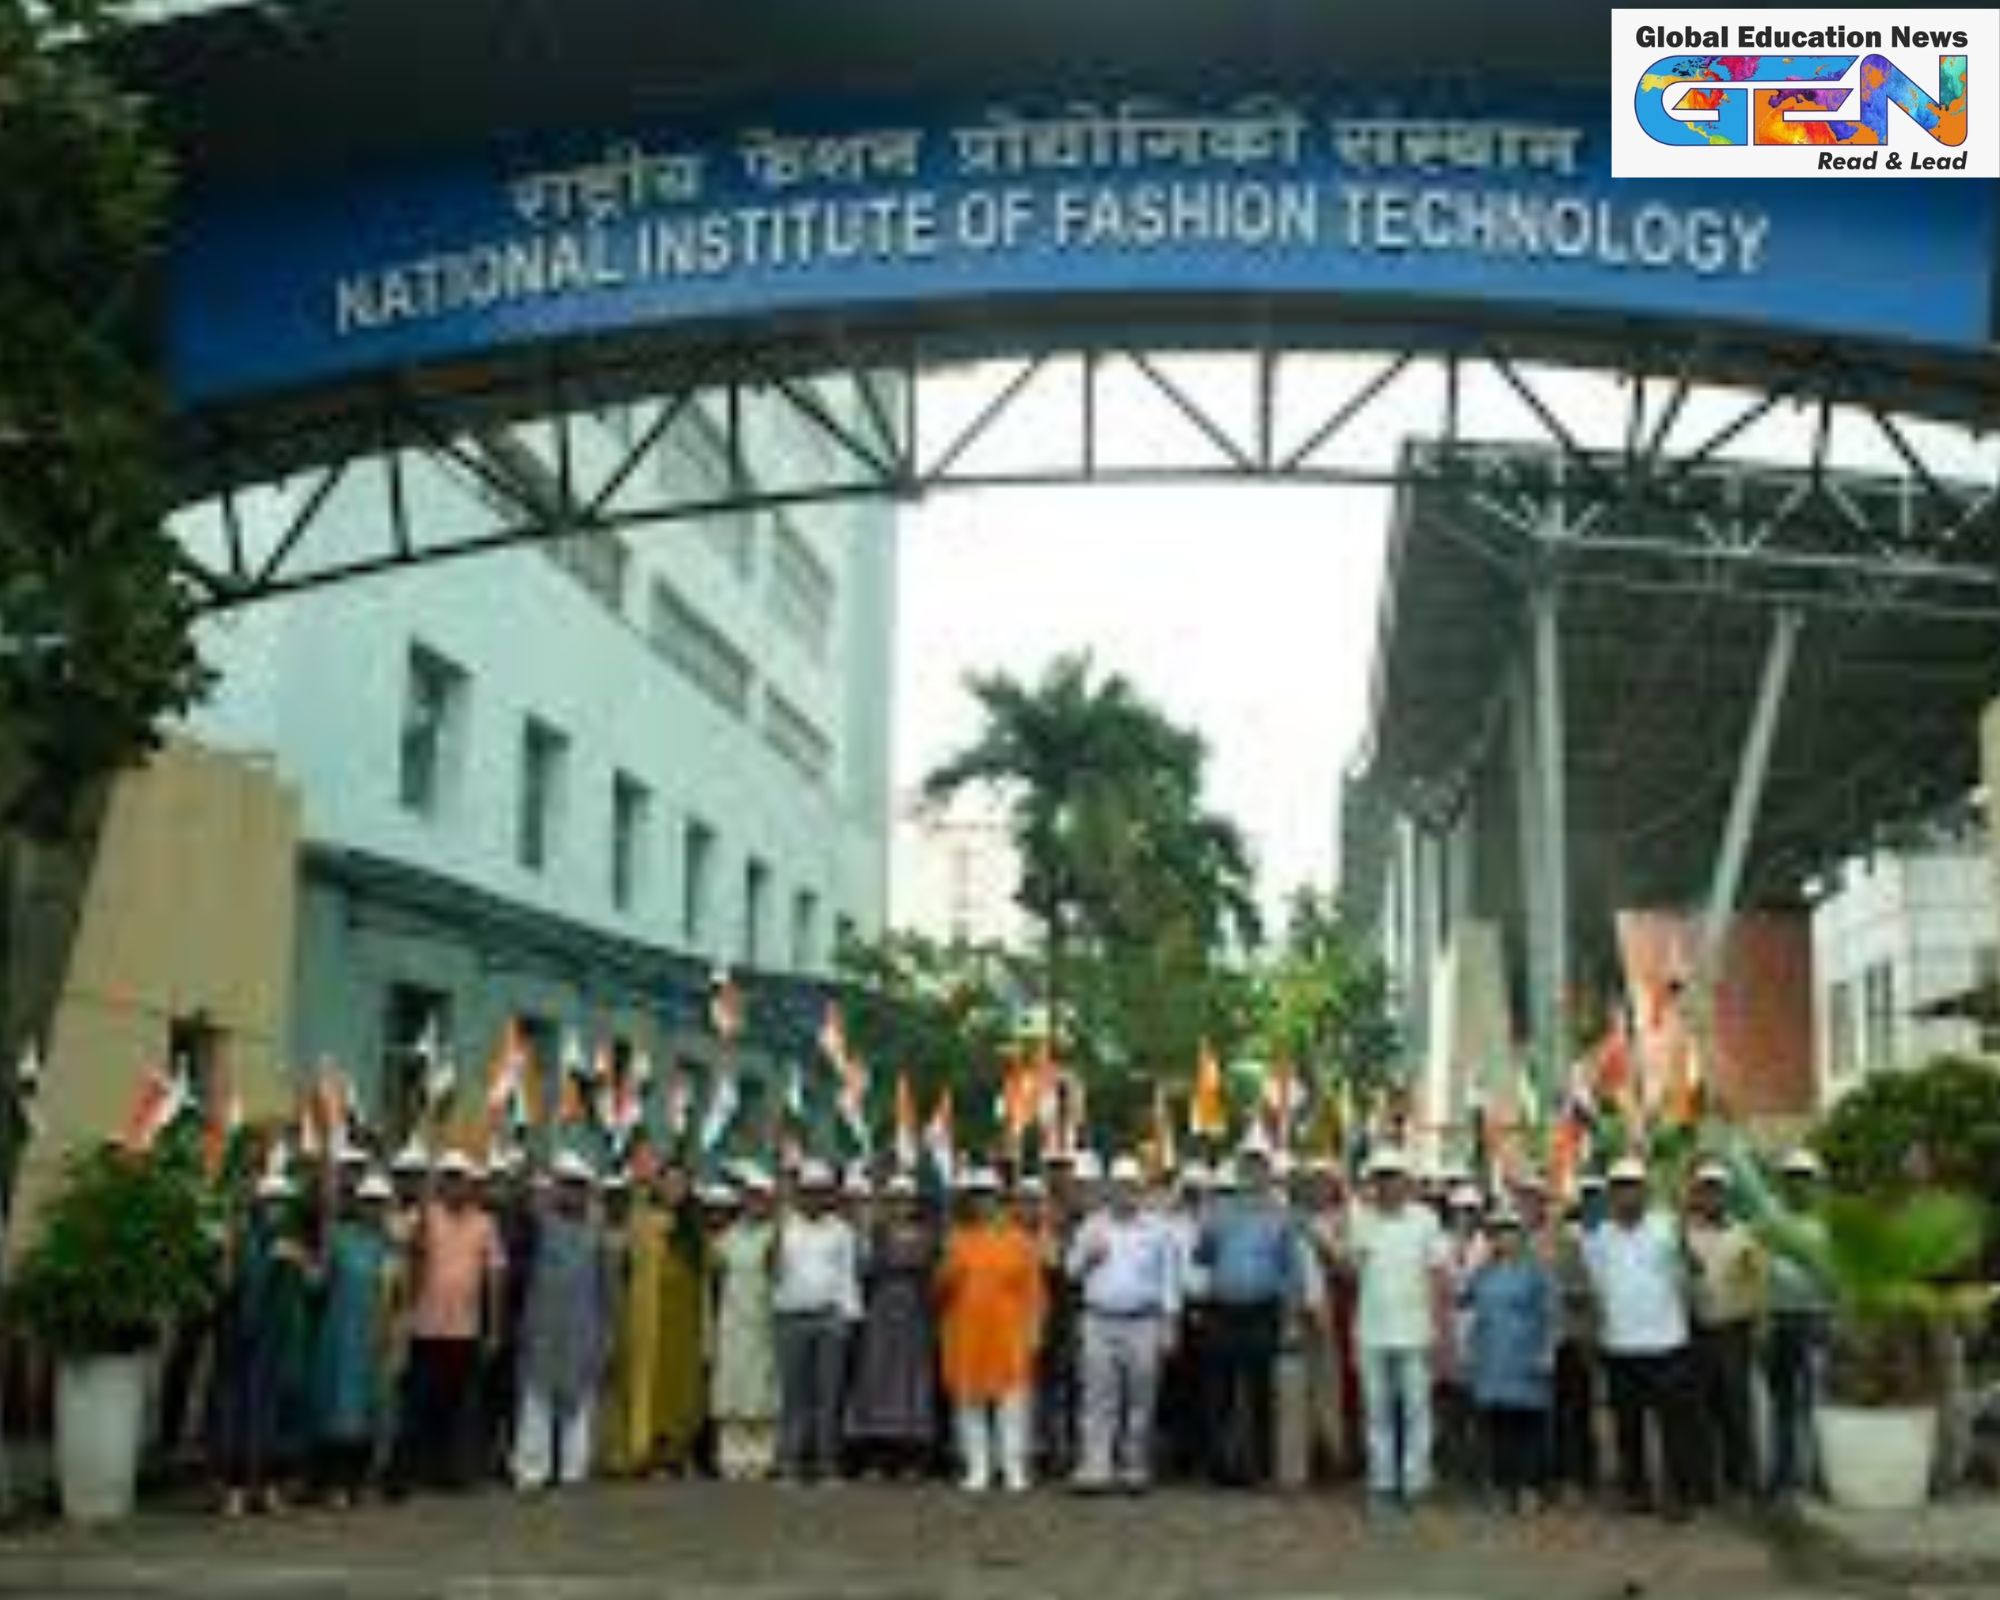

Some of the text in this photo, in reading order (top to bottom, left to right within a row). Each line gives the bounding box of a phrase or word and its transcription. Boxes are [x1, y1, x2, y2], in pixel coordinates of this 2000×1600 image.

[335, 181, 1769, 335] NATIONAL INSTITUTE OF FASHION TECHNOLOGY
